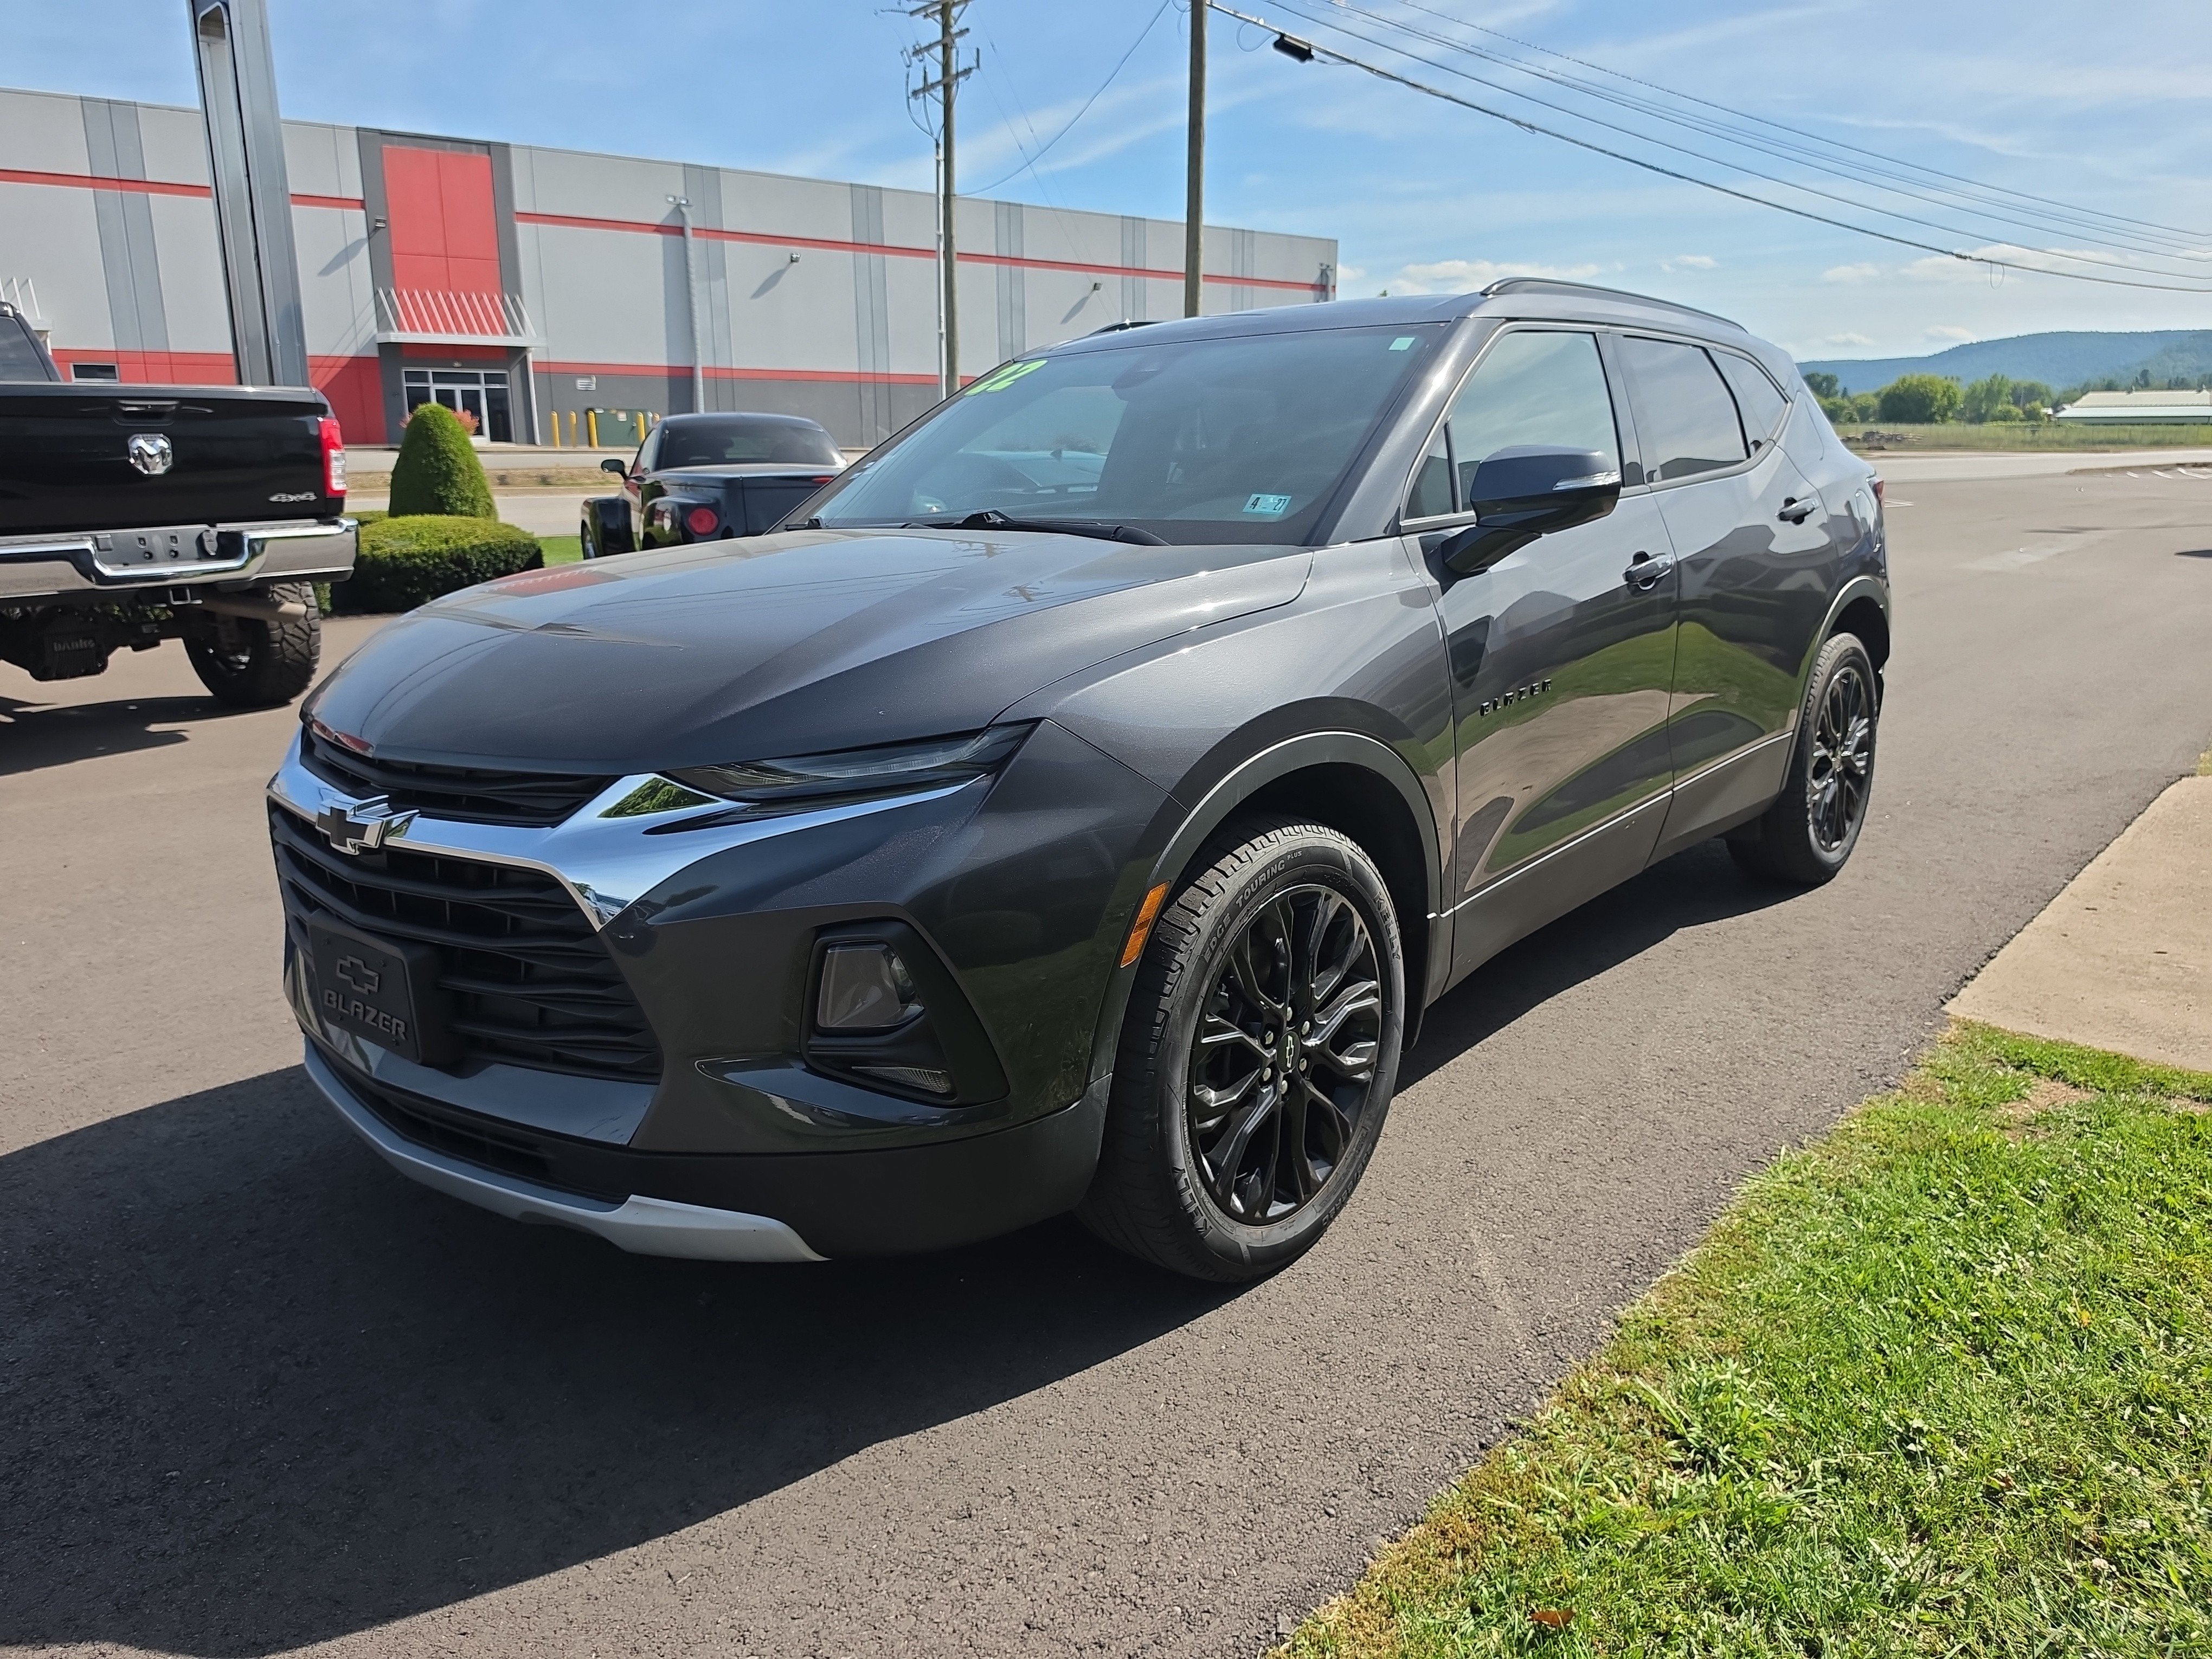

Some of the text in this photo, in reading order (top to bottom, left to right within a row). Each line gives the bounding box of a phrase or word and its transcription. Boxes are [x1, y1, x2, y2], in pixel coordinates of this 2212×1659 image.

[963, 359, 1049, 397] 22
[1273, 498, 1287, 512] 27
[1480, 678, 1552, 717] BLAZER
[1203, 912, 1231, 963] EDGE
[1236, 859, 1285, 909] TOURING
[1287, 850, 1302, 861] PLUS
[1373, 890, 1400, 960] KELLY
[325, 989, 407, 1040] BLAZER
[1172, 1165, 1213, 1239] KELLY
